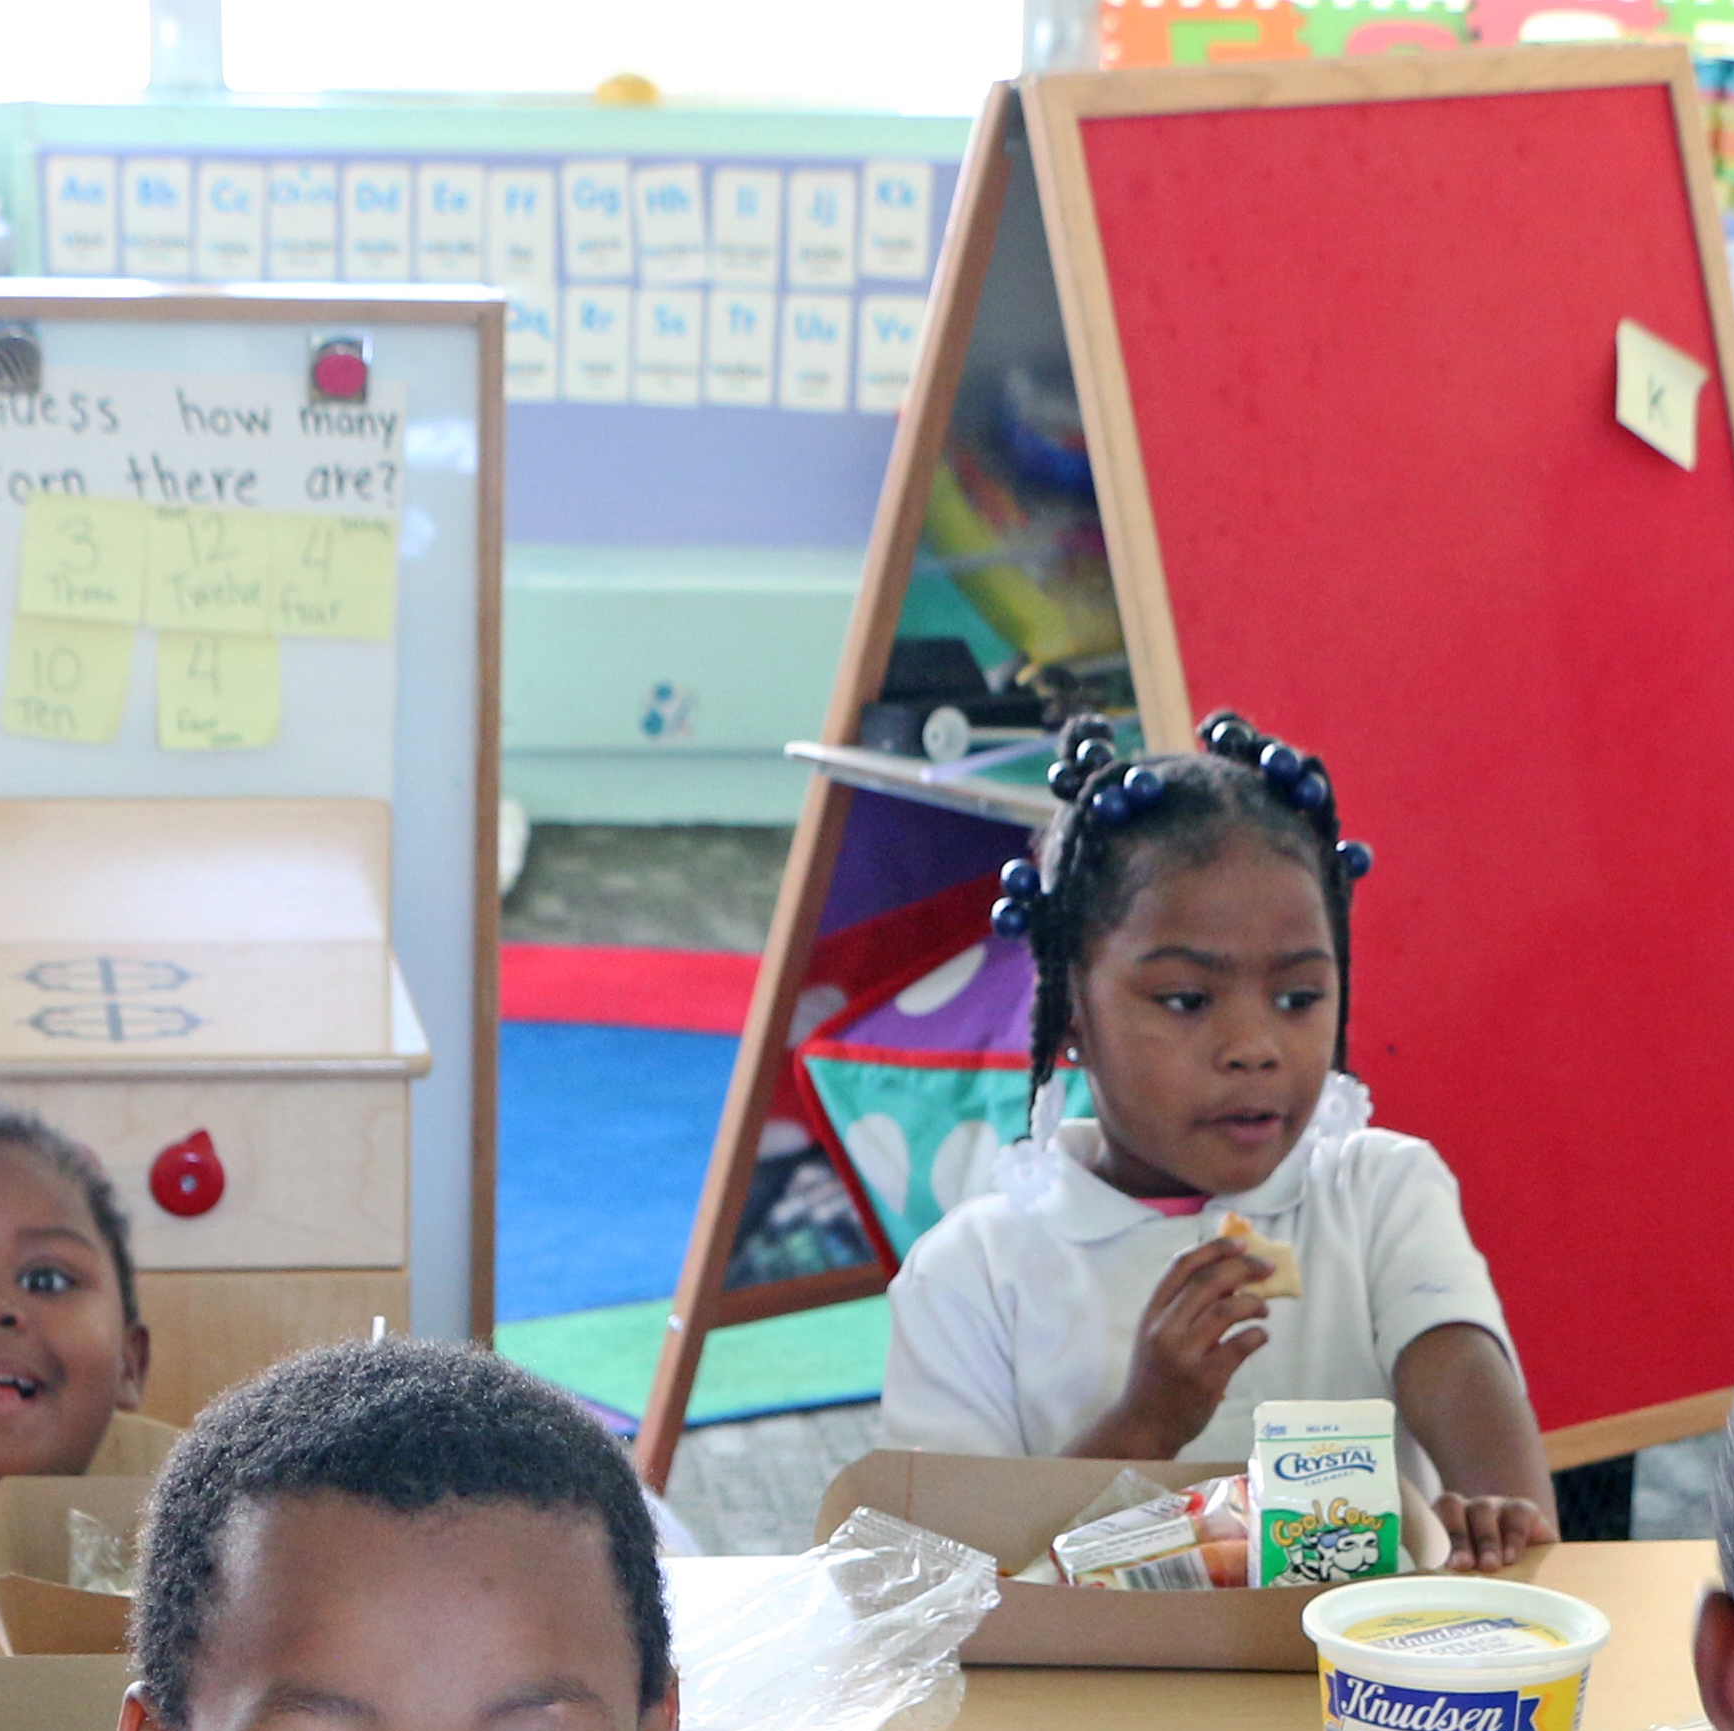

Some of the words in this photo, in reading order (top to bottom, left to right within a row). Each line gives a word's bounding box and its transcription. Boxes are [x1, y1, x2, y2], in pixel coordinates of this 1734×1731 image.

[175, 388, 272, 437] how
[298, 406, 398, 450] many
[1645, 376, 1667, 425] K
[126, 451, 260, 506] there
[305, 461, 398, 510] are?
[57, 516, 104, 575] 3
[186, 512, 245, 564] 12
[300, 517, 335, 590] 4
[31, 646, 84, 695] 10
[186, 640, 221, 696] 4
[1274, 1449, 1377, 1481] CRYSTAL
[1272, 1500, 1323, 1547] Cool
[1328, 1497, 1385, 1531] Cow
